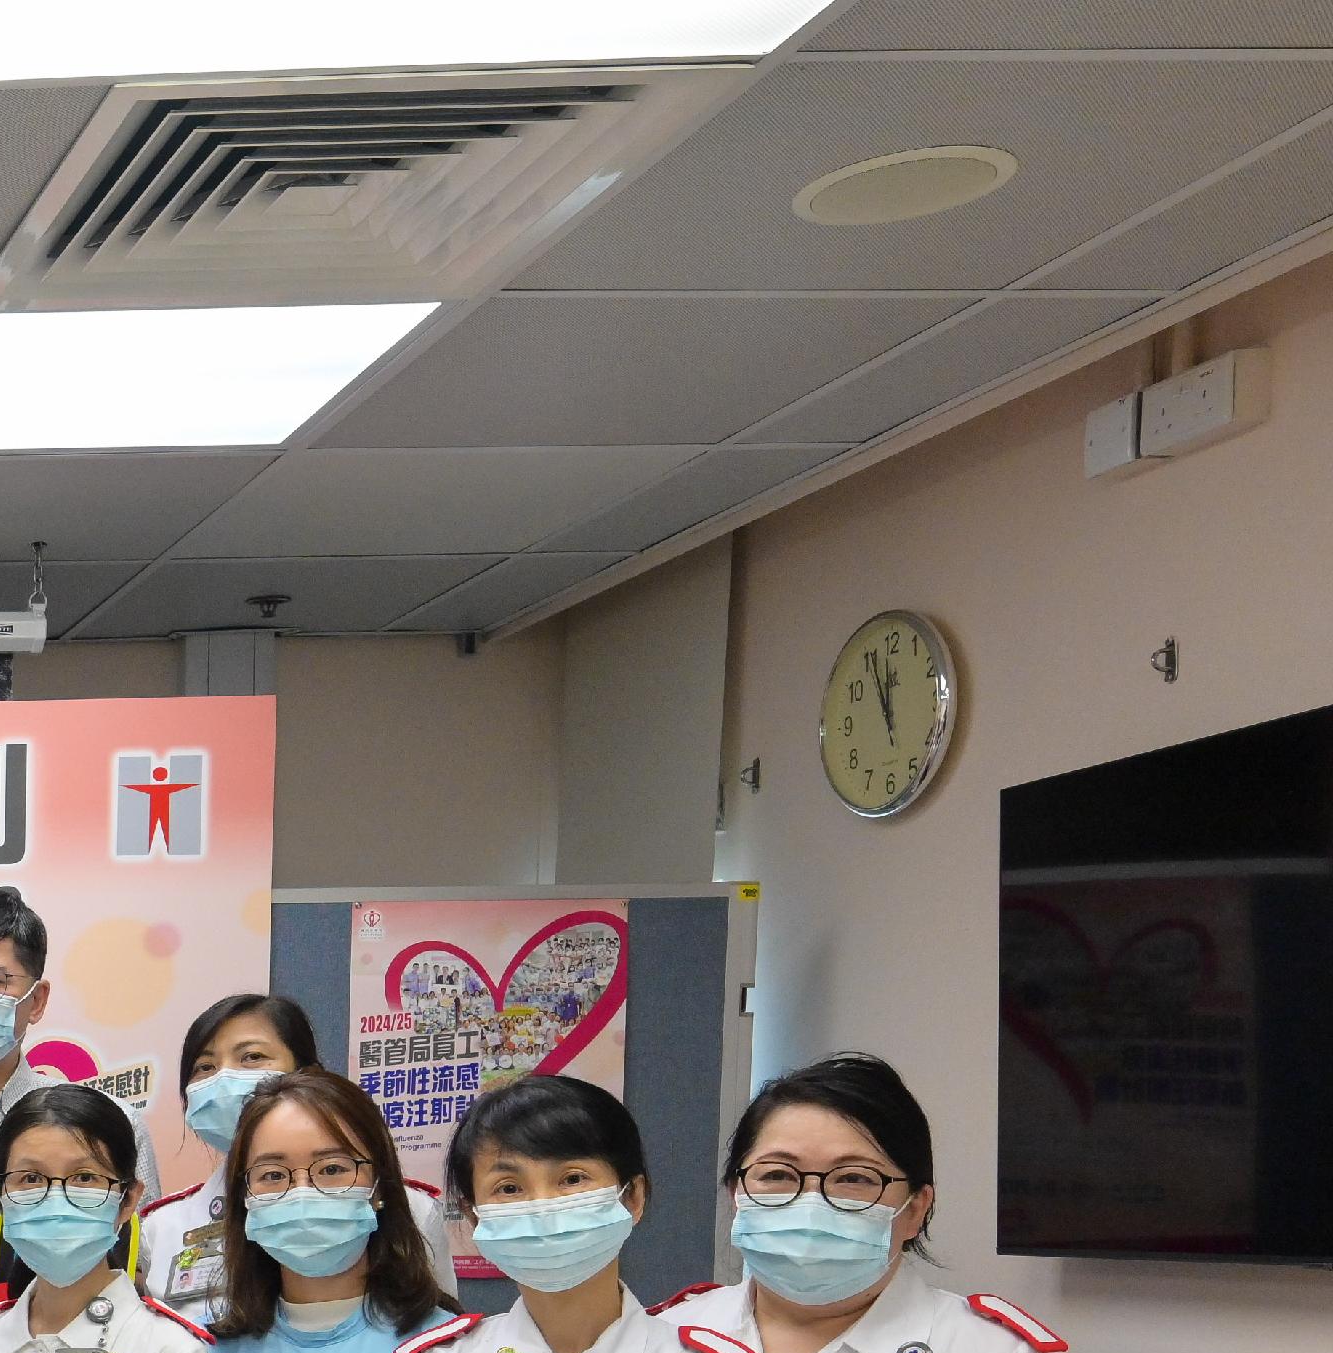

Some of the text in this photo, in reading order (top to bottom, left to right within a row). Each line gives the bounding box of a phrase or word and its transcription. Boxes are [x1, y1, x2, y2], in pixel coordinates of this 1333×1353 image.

[885, 632, 900, 656] 12
[912, 635, 918, 656] 1
[926, 657, 935, 679] 2
[847, 680, 863, 703] 10
[844, 715, 853, 736] 9
[849, 748, 858, 769] 8
[864, 769, 874, 791] 7
[885, 773, 895, 794] 6
[360, 1013, 412, 1033] 2024/25
[359, 1031, 479, 1069] 醫管局員工
[359, 1063, 479, 1098] 季節性流感
